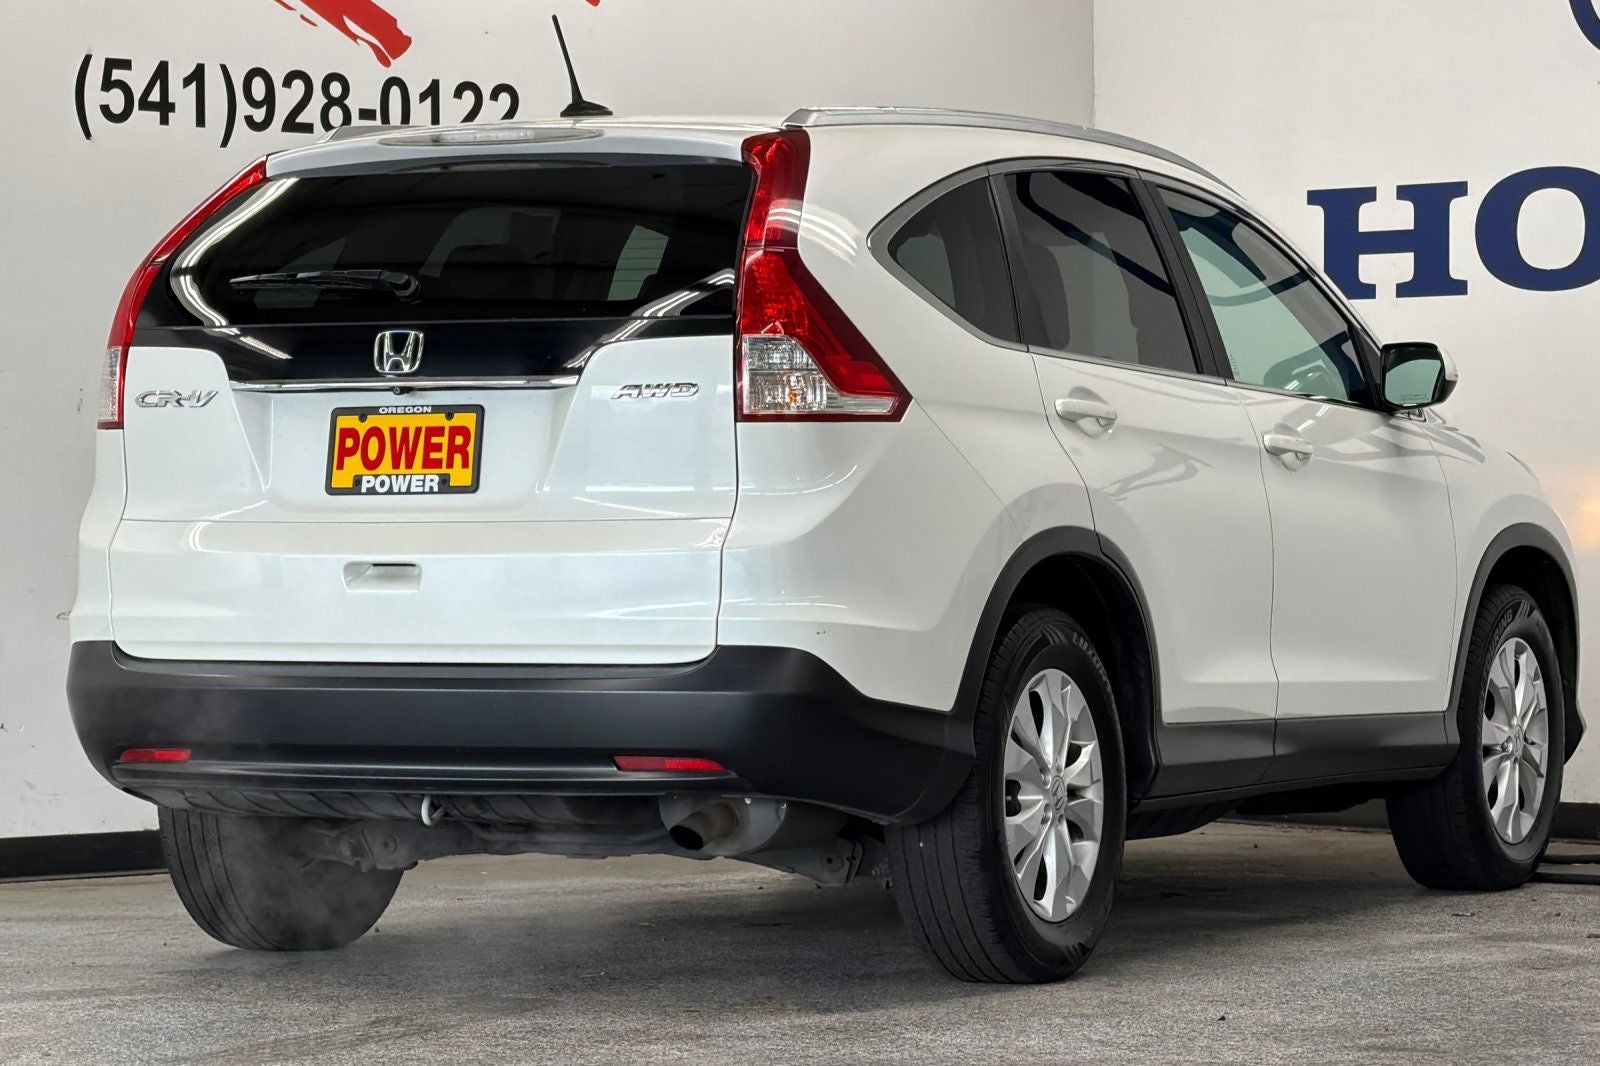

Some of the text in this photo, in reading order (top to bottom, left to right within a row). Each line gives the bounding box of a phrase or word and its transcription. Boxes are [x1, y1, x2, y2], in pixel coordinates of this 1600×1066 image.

[74, 53, 520, 148] (541)928-0122
[1306, 166, 1600, 300] HO
[135, 390, 219, 408] CR-V
[610, 382, 699, 400] AWD
[378, 405, 432, 414] OREGON
[336, 426, 472, 471] POWER
[360, 474, 440, 493] POWER
